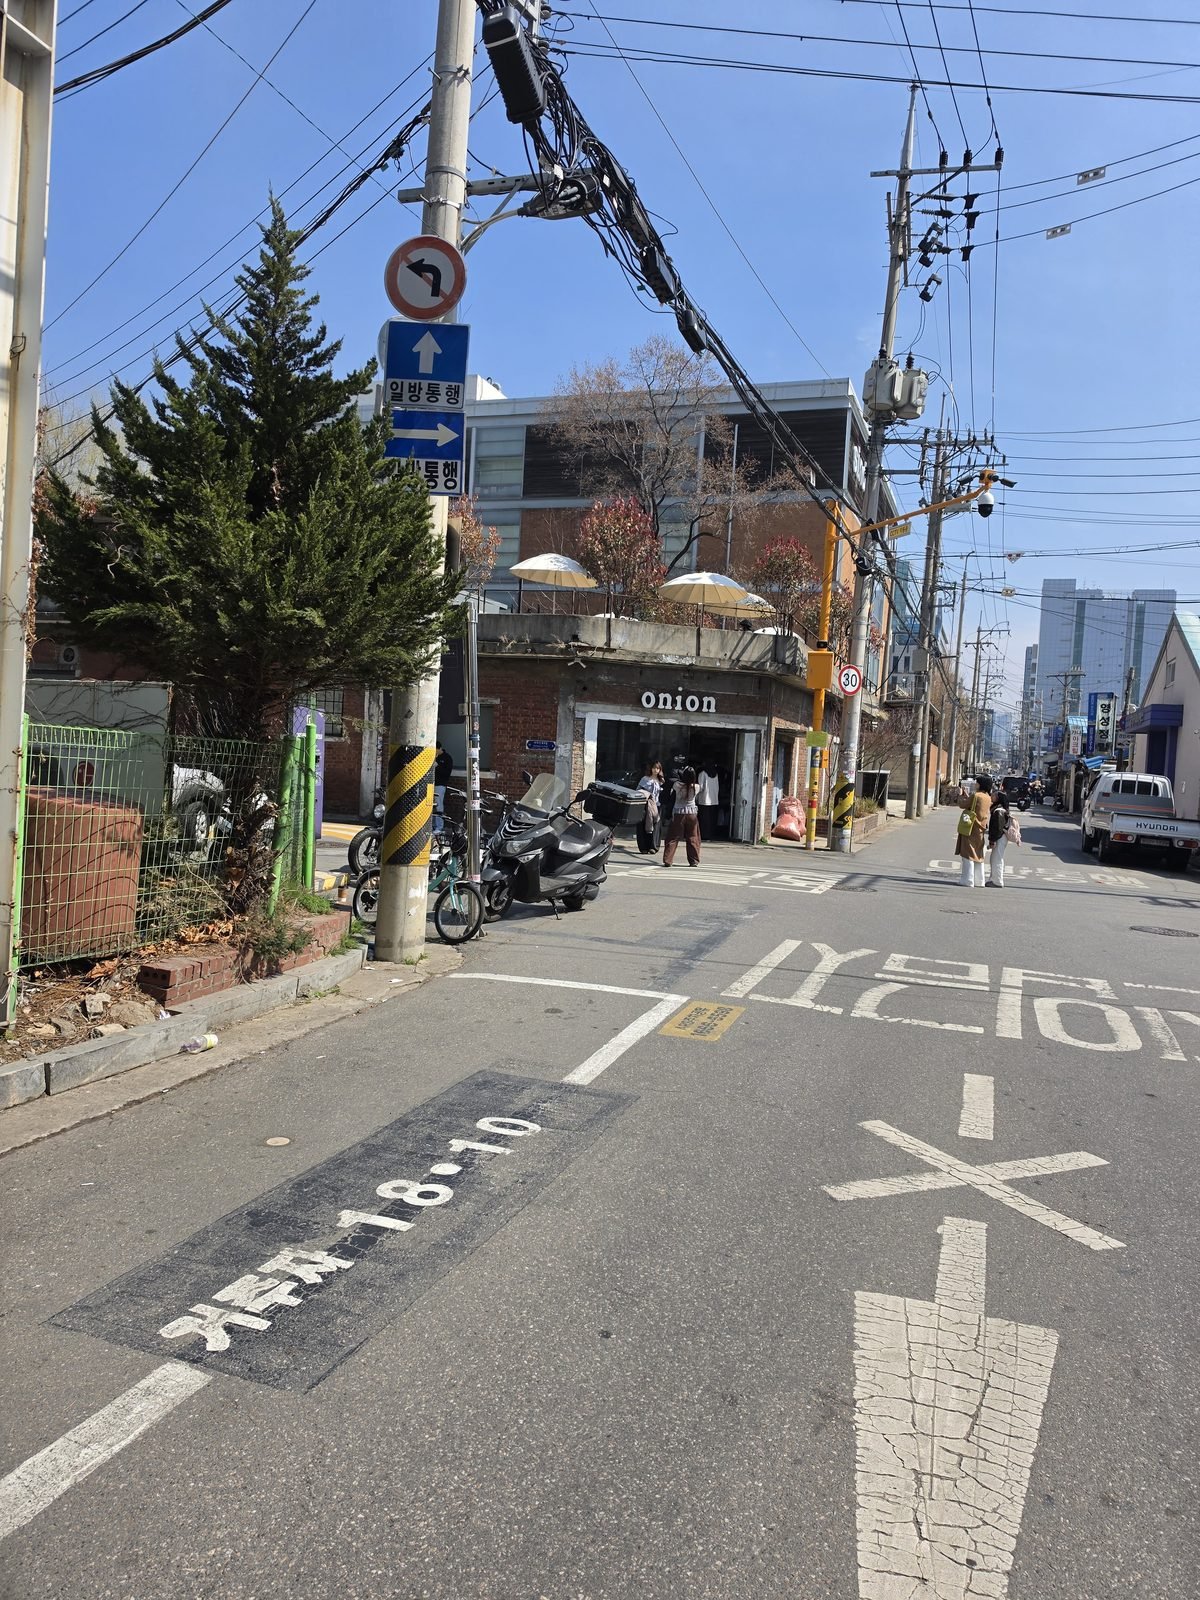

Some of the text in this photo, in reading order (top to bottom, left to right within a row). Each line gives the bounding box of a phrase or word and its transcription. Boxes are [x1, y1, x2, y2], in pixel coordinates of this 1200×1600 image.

[390, 381, 460, 405] 일방통행
[393, 459, 458, 490] 통행
[843, 673, 858, 687] 30
[641, 686, 716, 713] onion
[1136, 822, 1178, 832] HYUNDAI
[159, 1247, 354, 1351] 거주자
